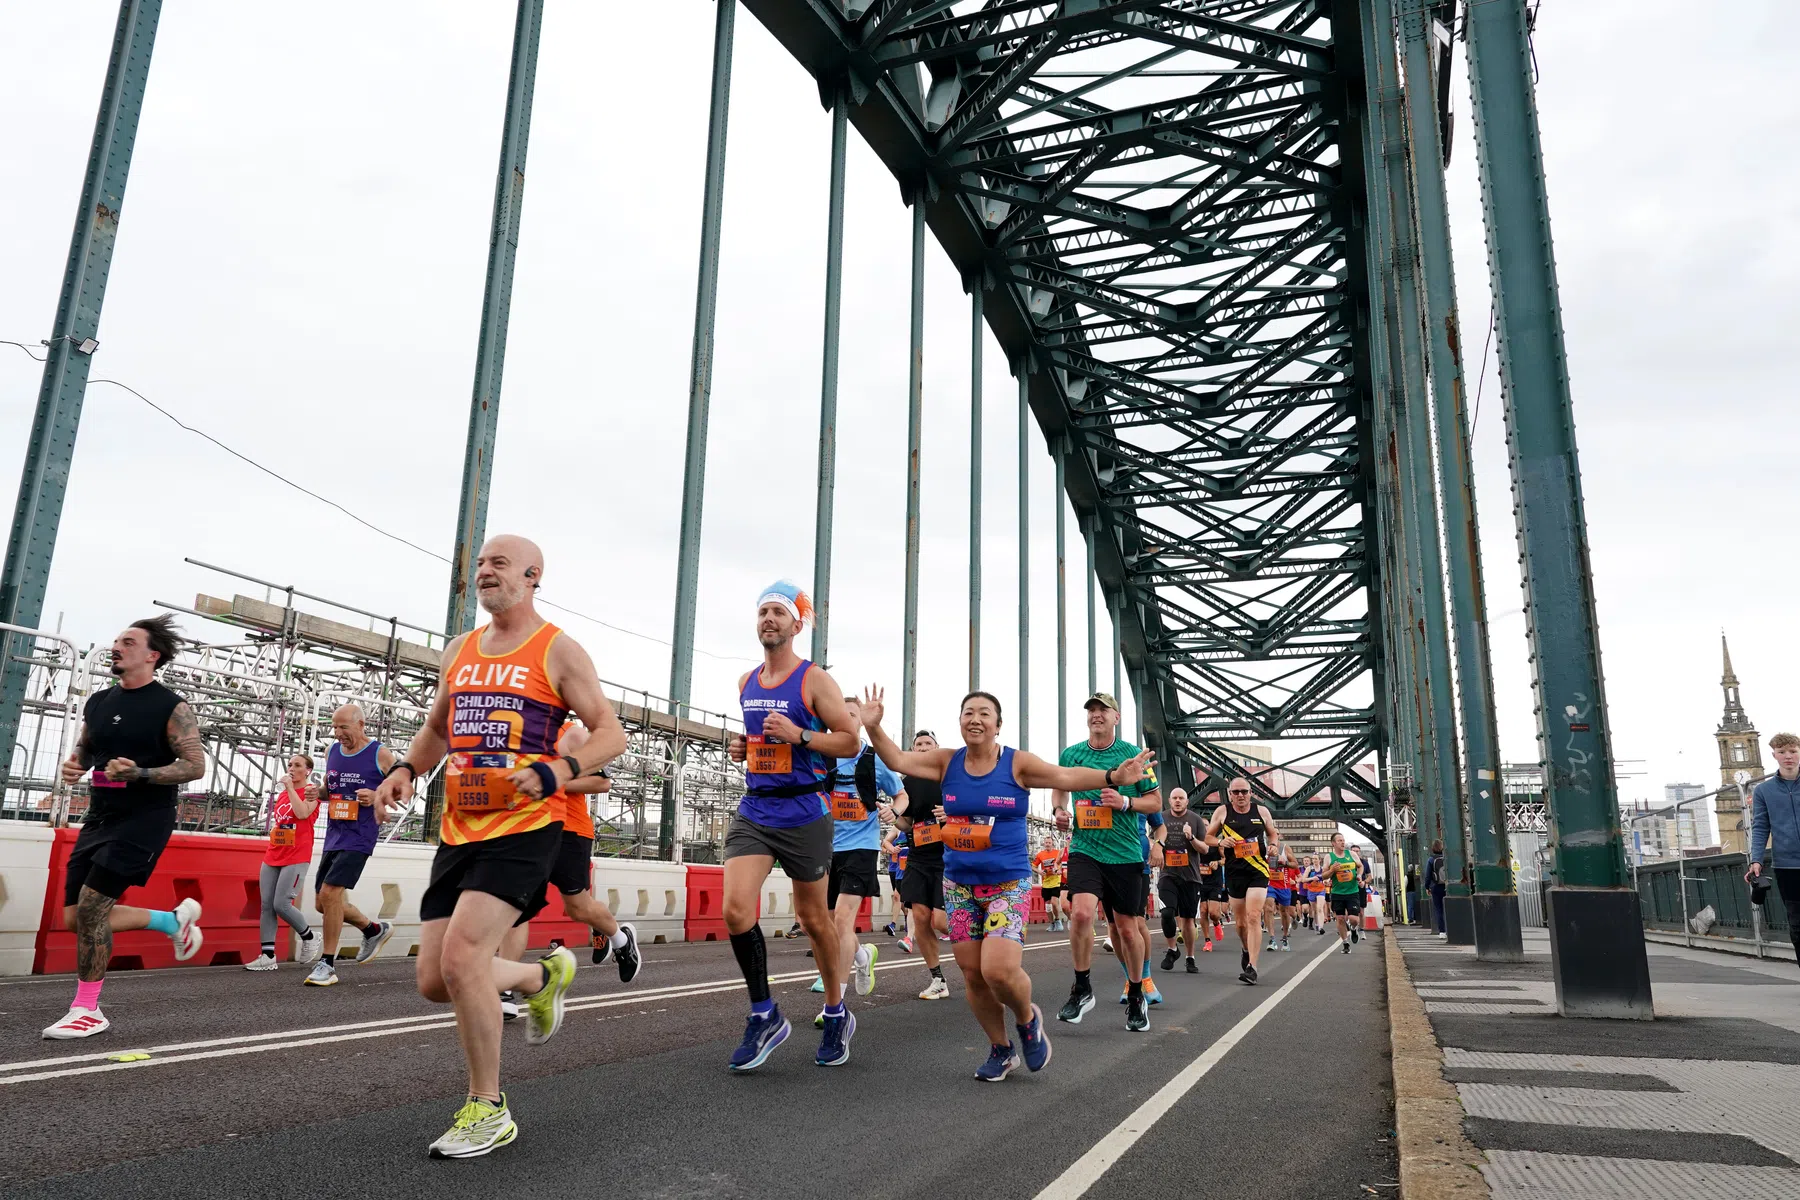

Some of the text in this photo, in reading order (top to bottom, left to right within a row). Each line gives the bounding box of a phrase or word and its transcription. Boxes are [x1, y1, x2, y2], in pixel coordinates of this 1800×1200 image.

[455, 664, 530, 689] CLIVE
[456, 696, 524, 710] CHILDREN
[743, 699, 776, 708] DIABETES
[455, 709, 485, 721] WITH
[453, 722, 508, 735] CANCER
[486, 735, 506, 748] UK
[460, 773, 487, 787] CLIVE
[837, 801, 859, 809] MICHAEL
[959, 827, 972, 835] YAN
